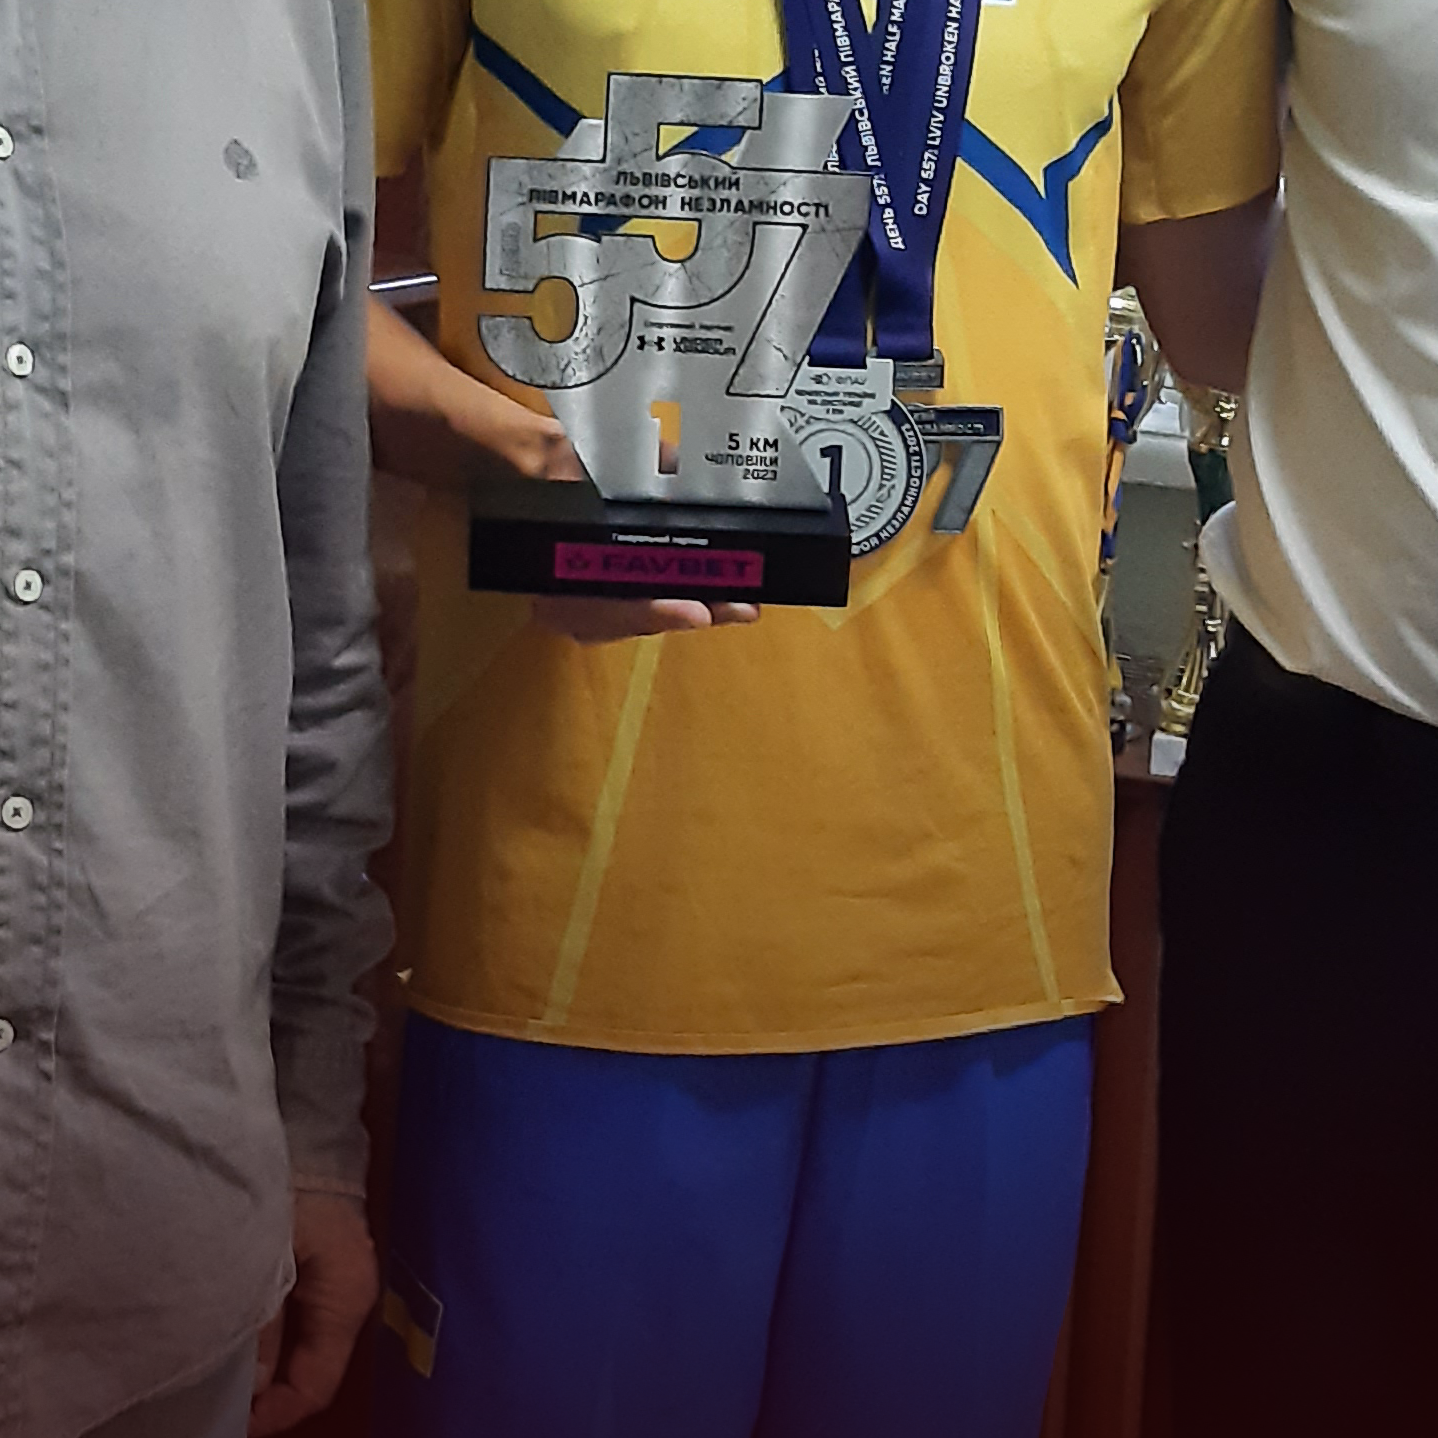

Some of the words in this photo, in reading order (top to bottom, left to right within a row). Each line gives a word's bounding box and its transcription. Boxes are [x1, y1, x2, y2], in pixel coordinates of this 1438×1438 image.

[882, 24, 901, 62] HALF
[933, 21, 959, 108] UNBROKEN
[927, 114, 944, 146] LVIV
[615, 170, 741, 192] ЛЬВІВСЬКИЙ
[529, 188, 668, 211] ПІВМАРАФОН
[680, 194, 831, 218] НЕЗЛАМНОСТІ
[914, 183, 932, 216] DAY
[883, 208, 906, 250] ДЕНЬ
[728, 432, 740, 451] 5
